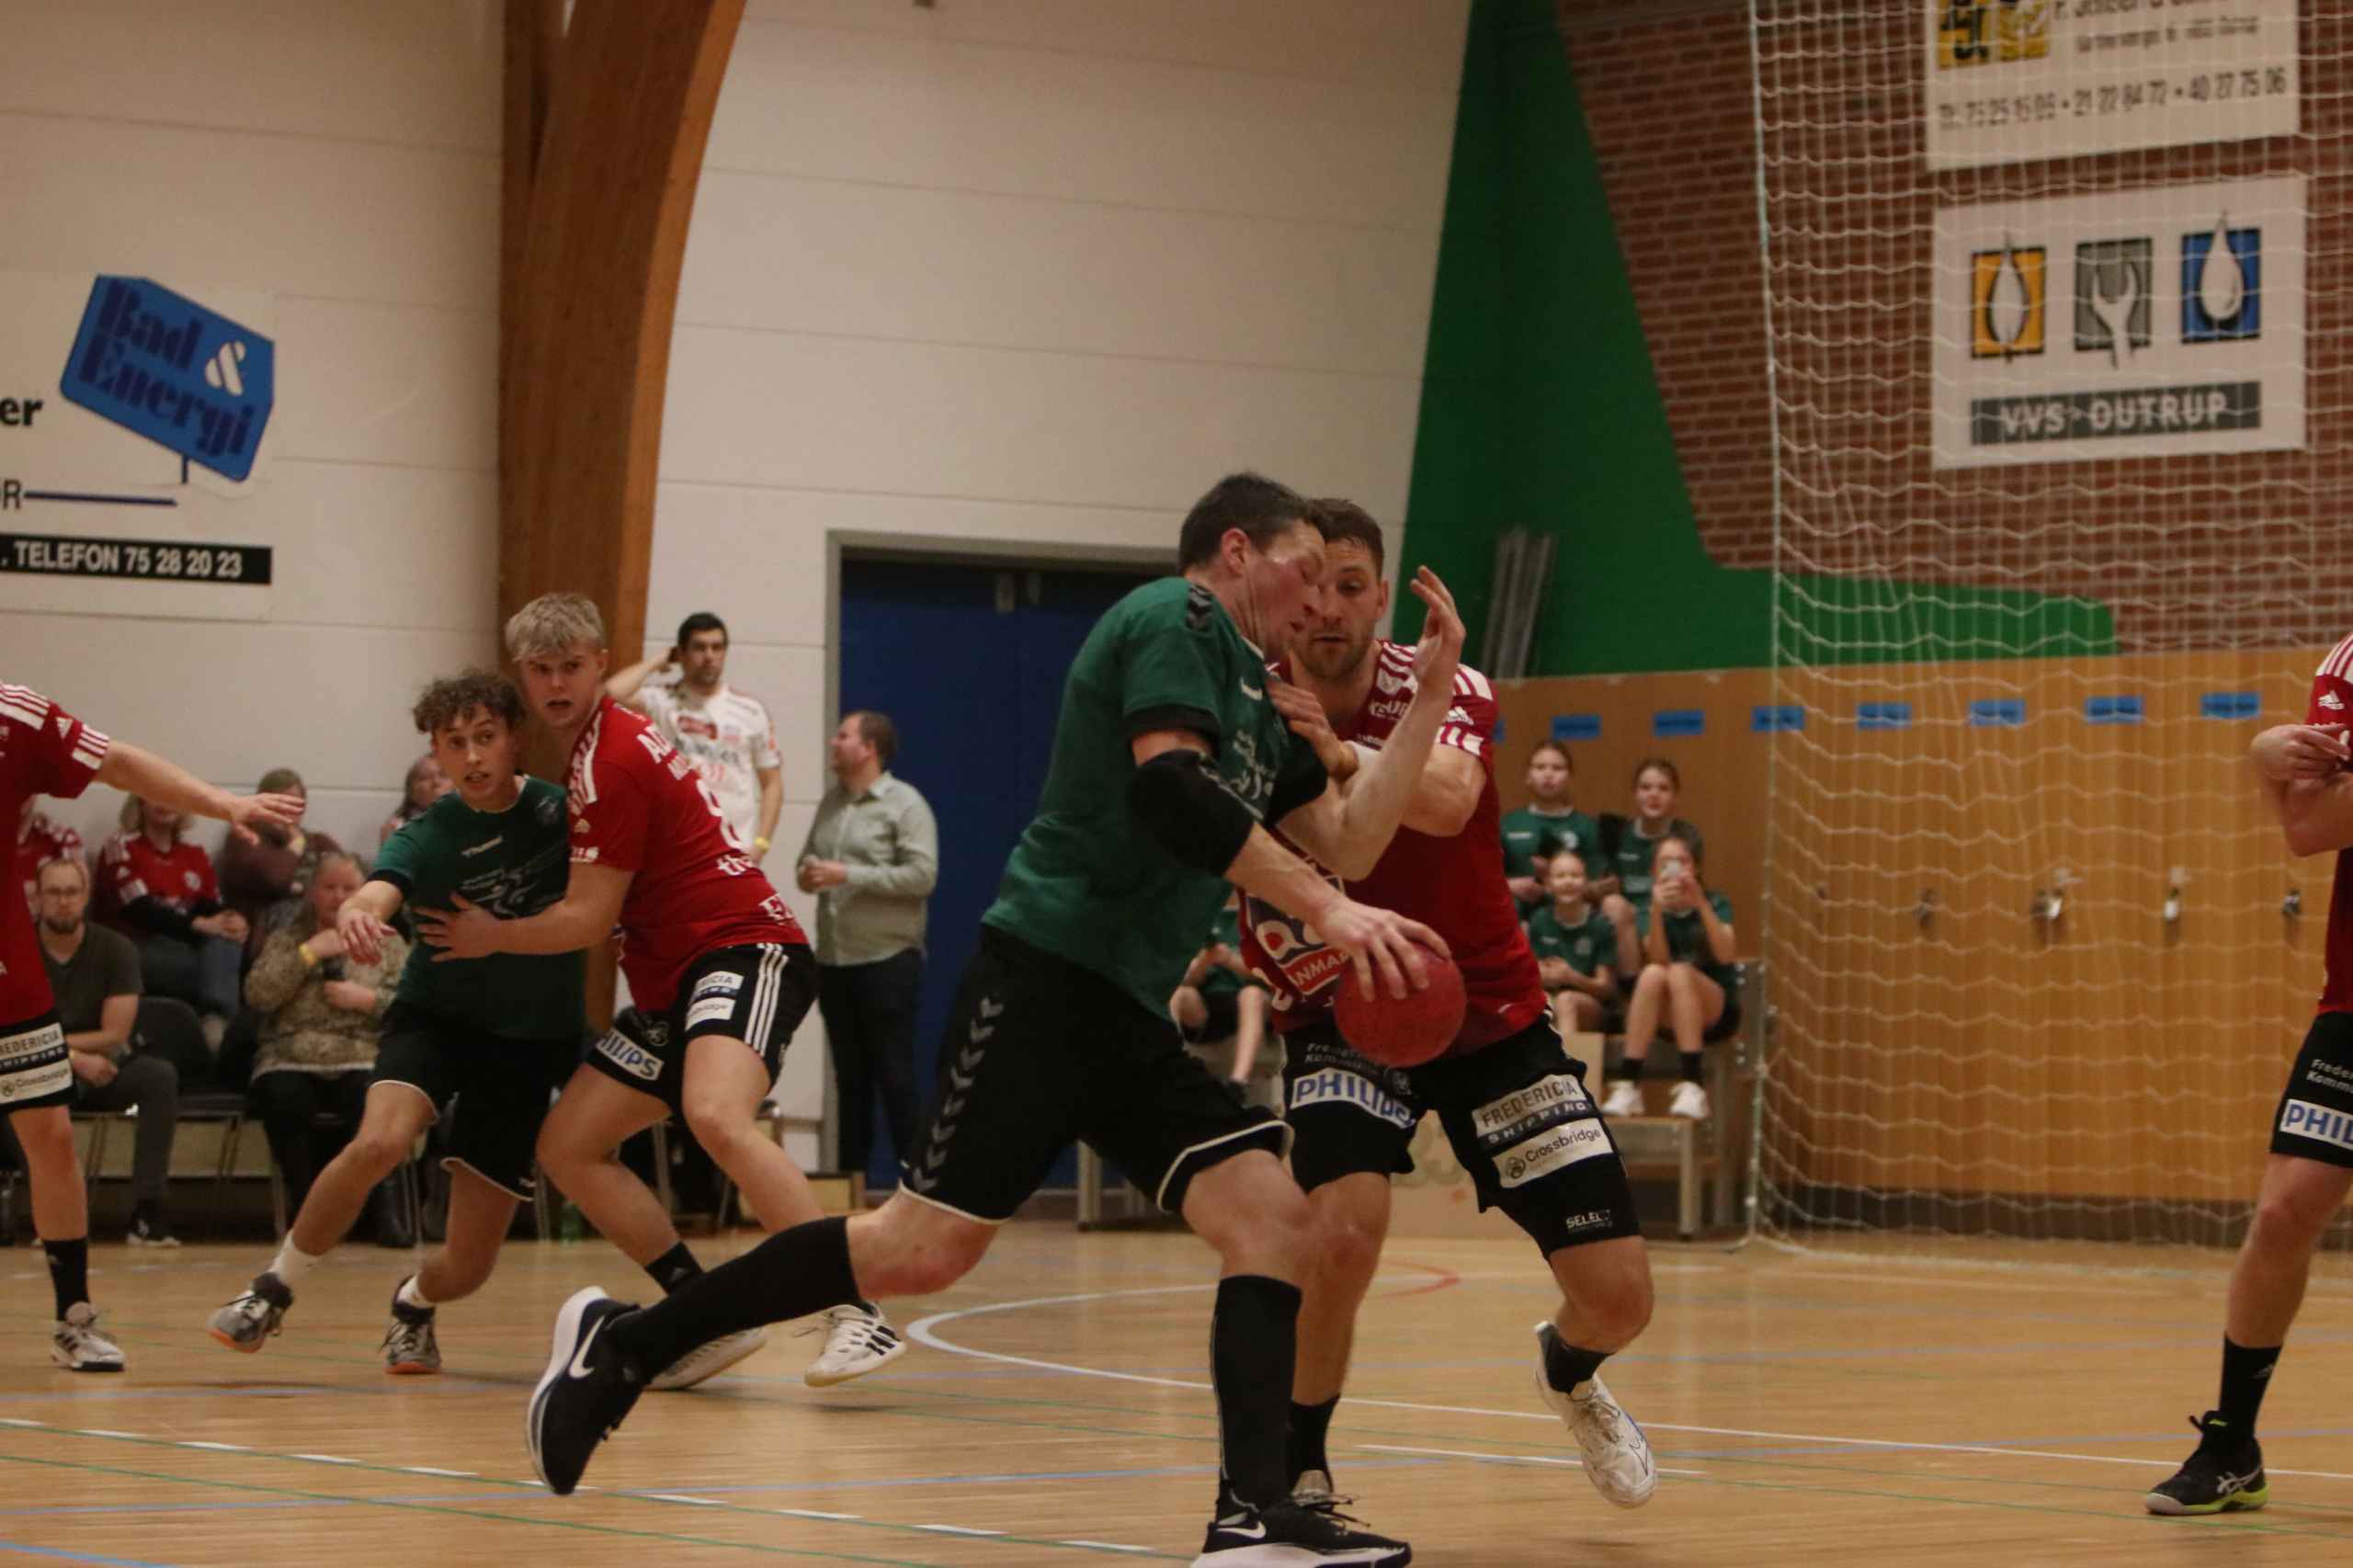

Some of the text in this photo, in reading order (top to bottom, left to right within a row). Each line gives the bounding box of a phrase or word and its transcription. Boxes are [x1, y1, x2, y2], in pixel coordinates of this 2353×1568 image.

[14, 540, 243, 579] TELEFON 75 28 20 23
[1481, 1080, 1577, 1128] FREDERICIA
[1488, 1102, 1588, 1144] SHIPPING
[1525, 1128, 1602, 1163] Crossbridge
